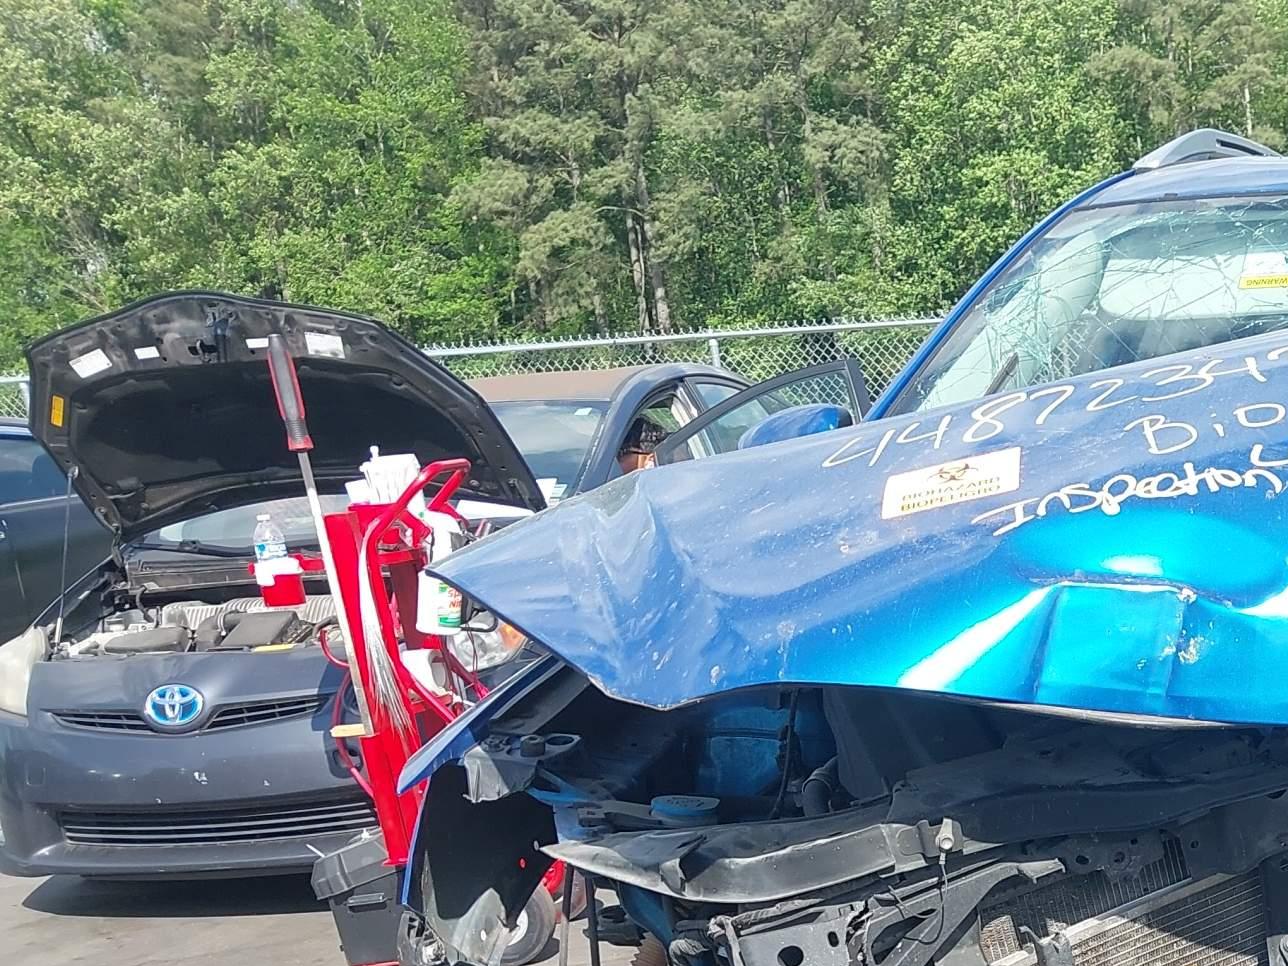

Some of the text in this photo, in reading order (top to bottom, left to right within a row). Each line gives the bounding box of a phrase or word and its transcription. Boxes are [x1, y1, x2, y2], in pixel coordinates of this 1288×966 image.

[1246, 276, 1288, 287] WARNING
[900, 485, 1001, 512] BIOPELIGRO
[902, 476, 1001, 502] BIOHAZARD
